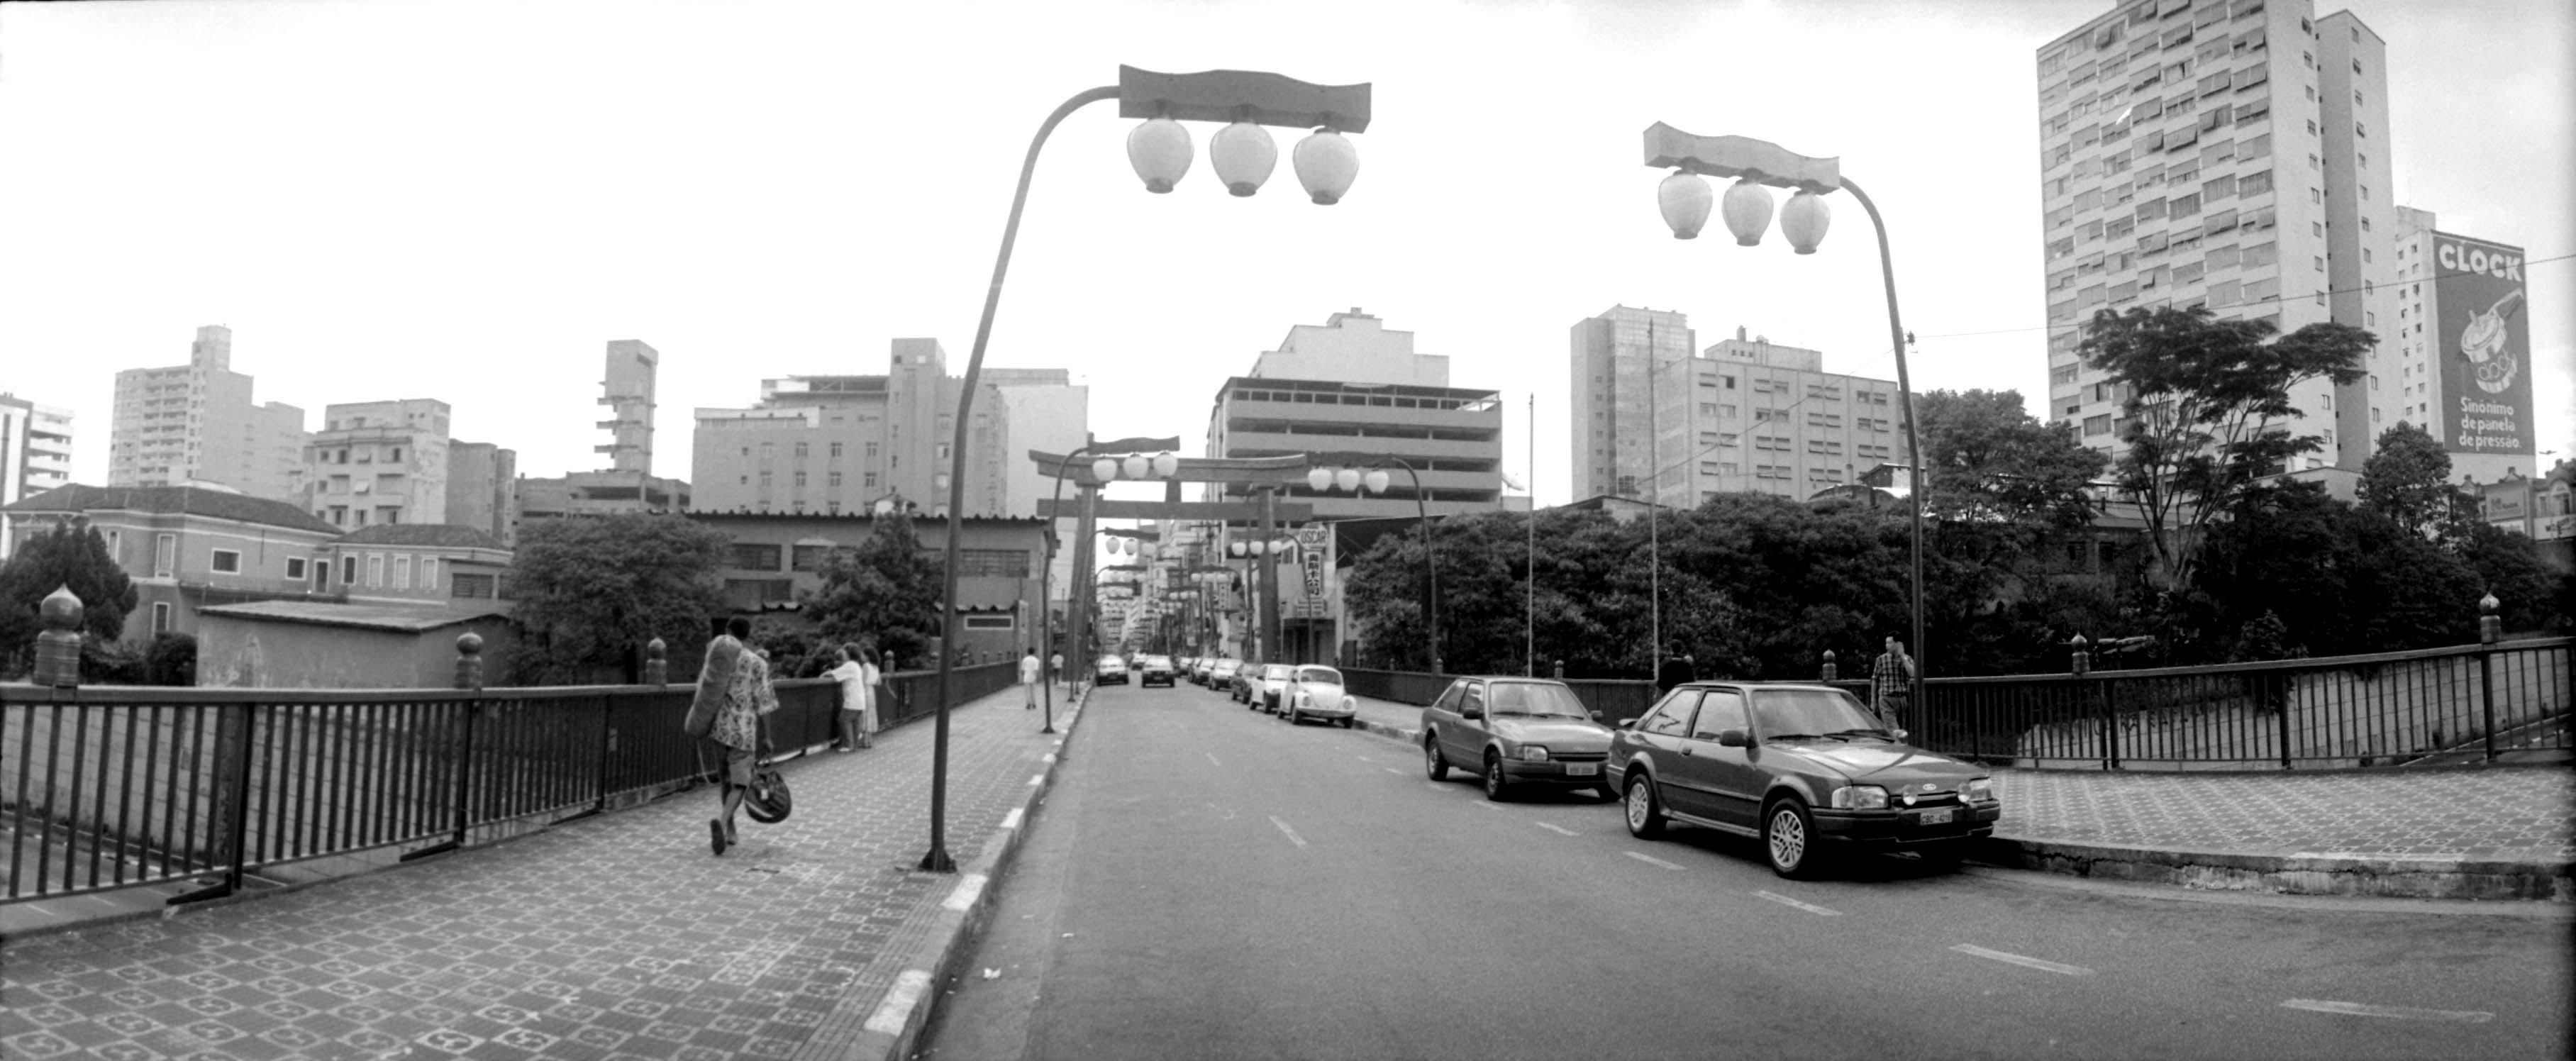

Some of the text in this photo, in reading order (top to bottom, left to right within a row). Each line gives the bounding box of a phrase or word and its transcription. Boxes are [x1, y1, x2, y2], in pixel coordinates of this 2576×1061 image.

[2439, 243, 2522, 282] CLOCK
[2461, 413, 2515, 435] de panela
[2459, 430, 2473, 446] de
